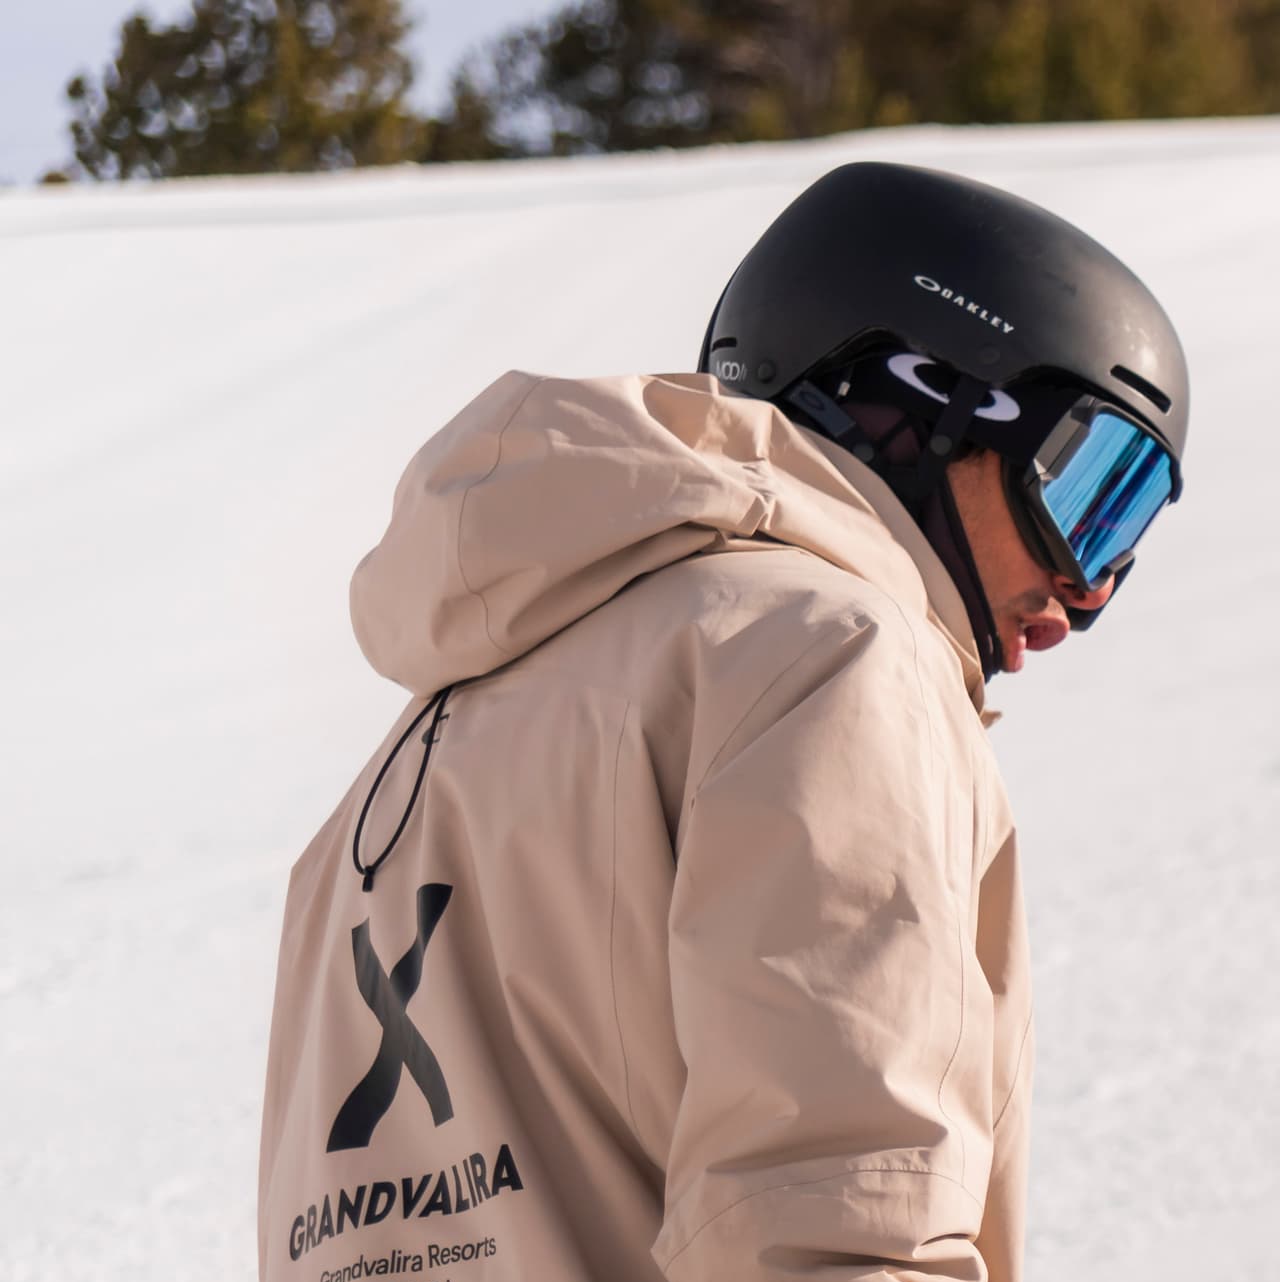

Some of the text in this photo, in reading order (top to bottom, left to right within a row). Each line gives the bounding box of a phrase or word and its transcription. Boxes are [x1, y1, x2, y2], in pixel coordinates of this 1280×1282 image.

[941, 288, 1014, 333] OAKLEY
[289, 1144, 523, 1261] GRANDVALIRA
[428, 1236, 497, 1269] Resorts
